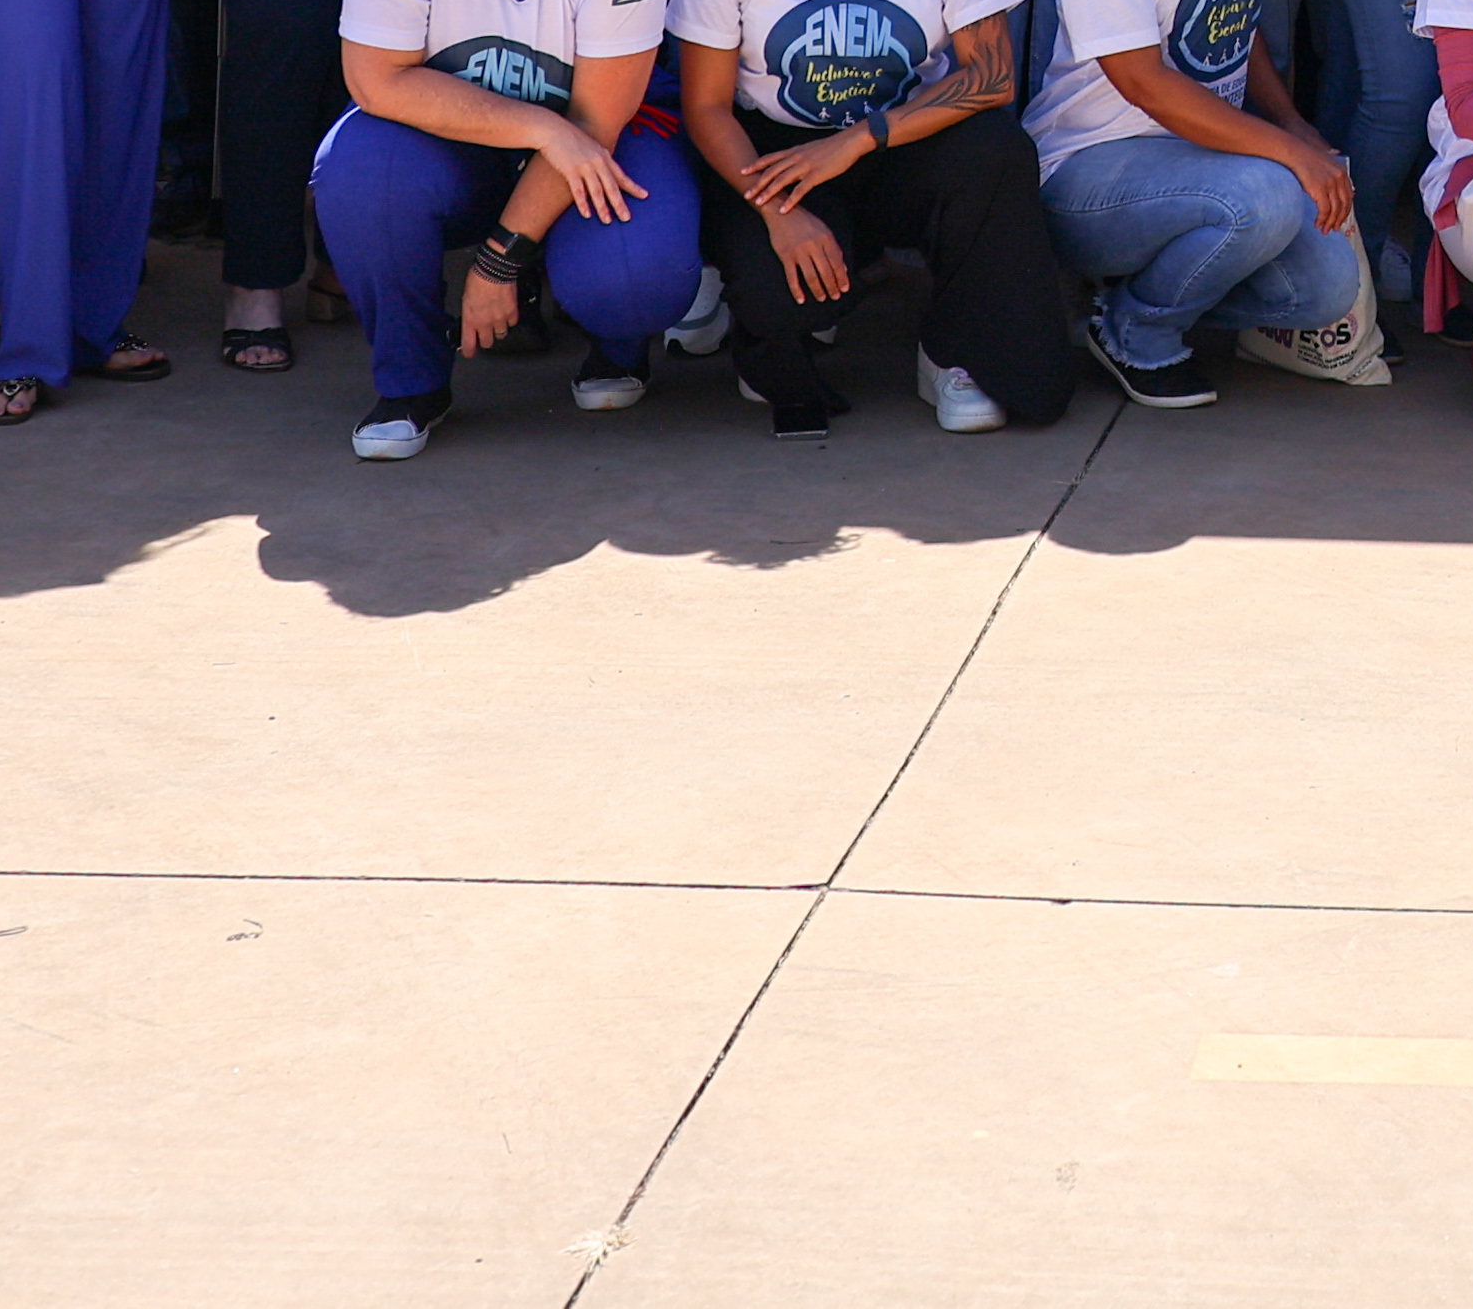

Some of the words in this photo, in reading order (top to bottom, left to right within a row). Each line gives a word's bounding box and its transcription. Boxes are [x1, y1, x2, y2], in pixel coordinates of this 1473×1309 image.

[805, 3, 893, 57] ENEM
[465, 47, 547, 102] ENEM
[805, 61, 873, 83] Inclusivo
[816, 81, 876, 106] Especial
